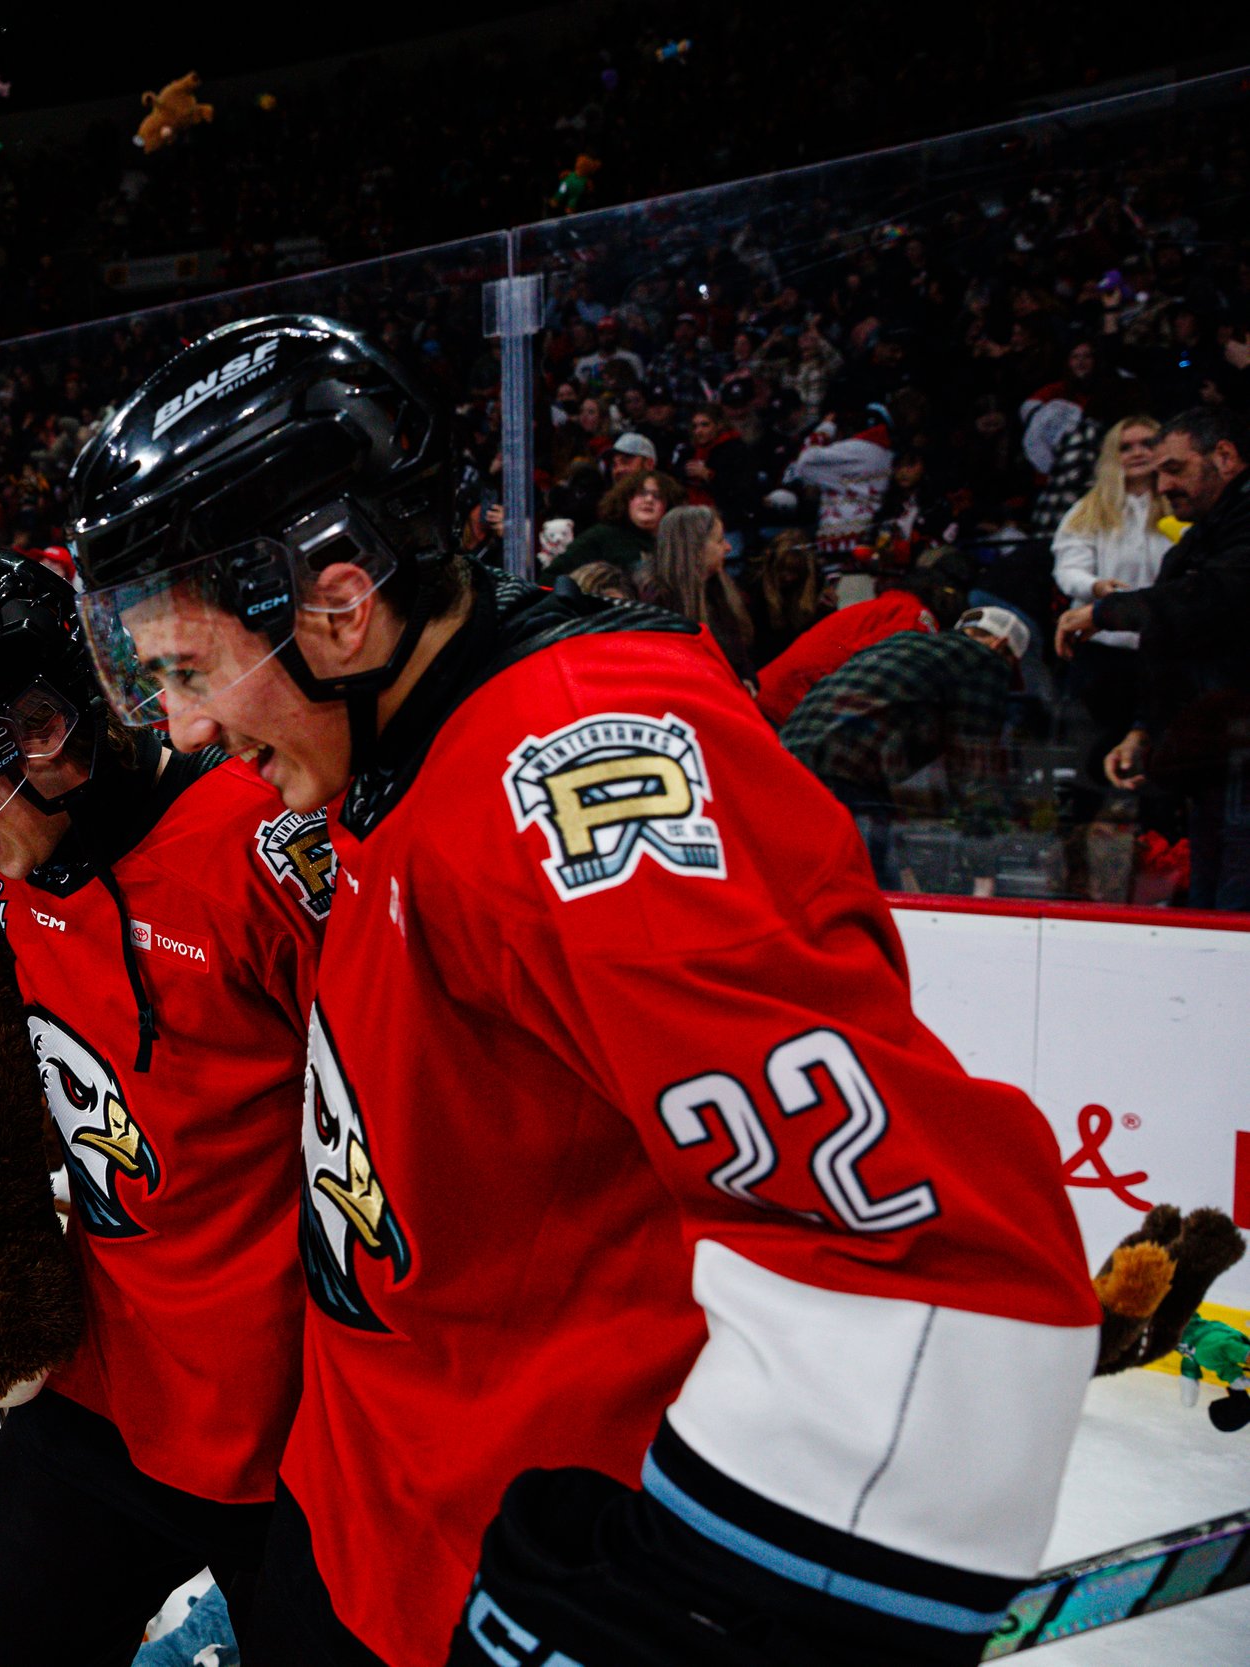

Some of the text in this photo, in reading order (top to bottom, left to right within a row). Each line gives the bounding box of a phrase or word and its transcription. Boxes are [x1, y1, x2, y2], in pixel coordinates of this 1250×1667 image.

[153, 337, 281, 431] BNSF
[216, 360, 277, 400] RAILWAY
[246, 593, 289, 616] CCM
[532, 725, 671, 772] WINTERHAWKS
[545, 755, 692, 857] P
[154, 933, 206, 962] TOYOTA
[657, 1026, 942, 1233] 22
